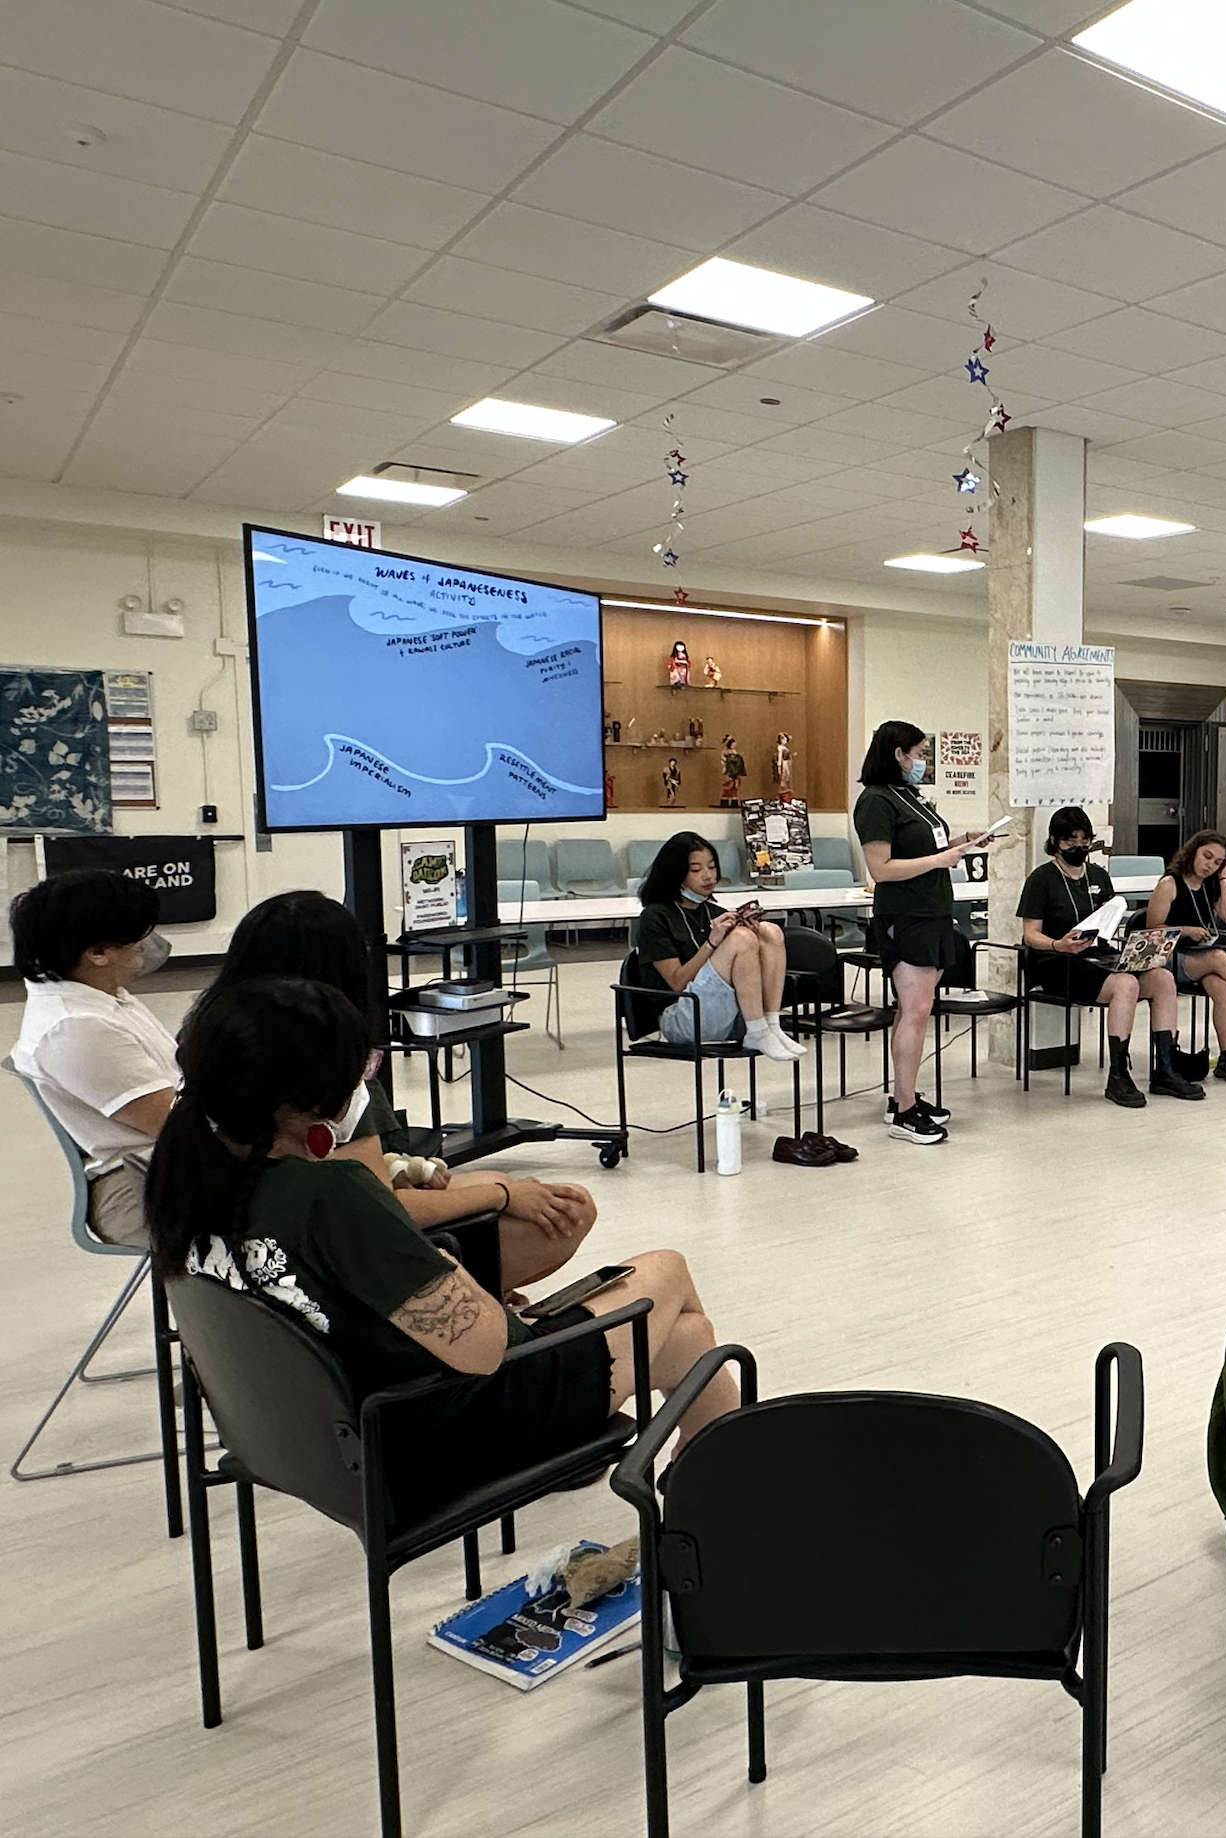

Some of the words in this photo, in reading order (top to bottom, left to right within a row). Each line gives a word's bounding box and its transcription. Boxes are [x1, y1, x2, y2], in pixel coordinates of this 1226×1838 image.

[329, 520, 374, 549] EXIT
[374, 566, 415, 581] WAVES
[437, 577, 528, 604] JAPANESENESS
[429, 590, 476, 606] ACTIVITY
[386, 635, 427, 646] JAPANESE
[451, 626, 477, 639] POWER
[1010, 642, 1057, 662] COMMUNITY
[339, 743, 390, 775] JAPANESE
[349, 758, 412, 798] IMPERIALISM
[499, 753, 558, 796] RESETTLEMENT
[508, 771, 546, 801] PATTERNS
[123, 864, 158, 880] ARE
[162, 862, 190, 875] ON
